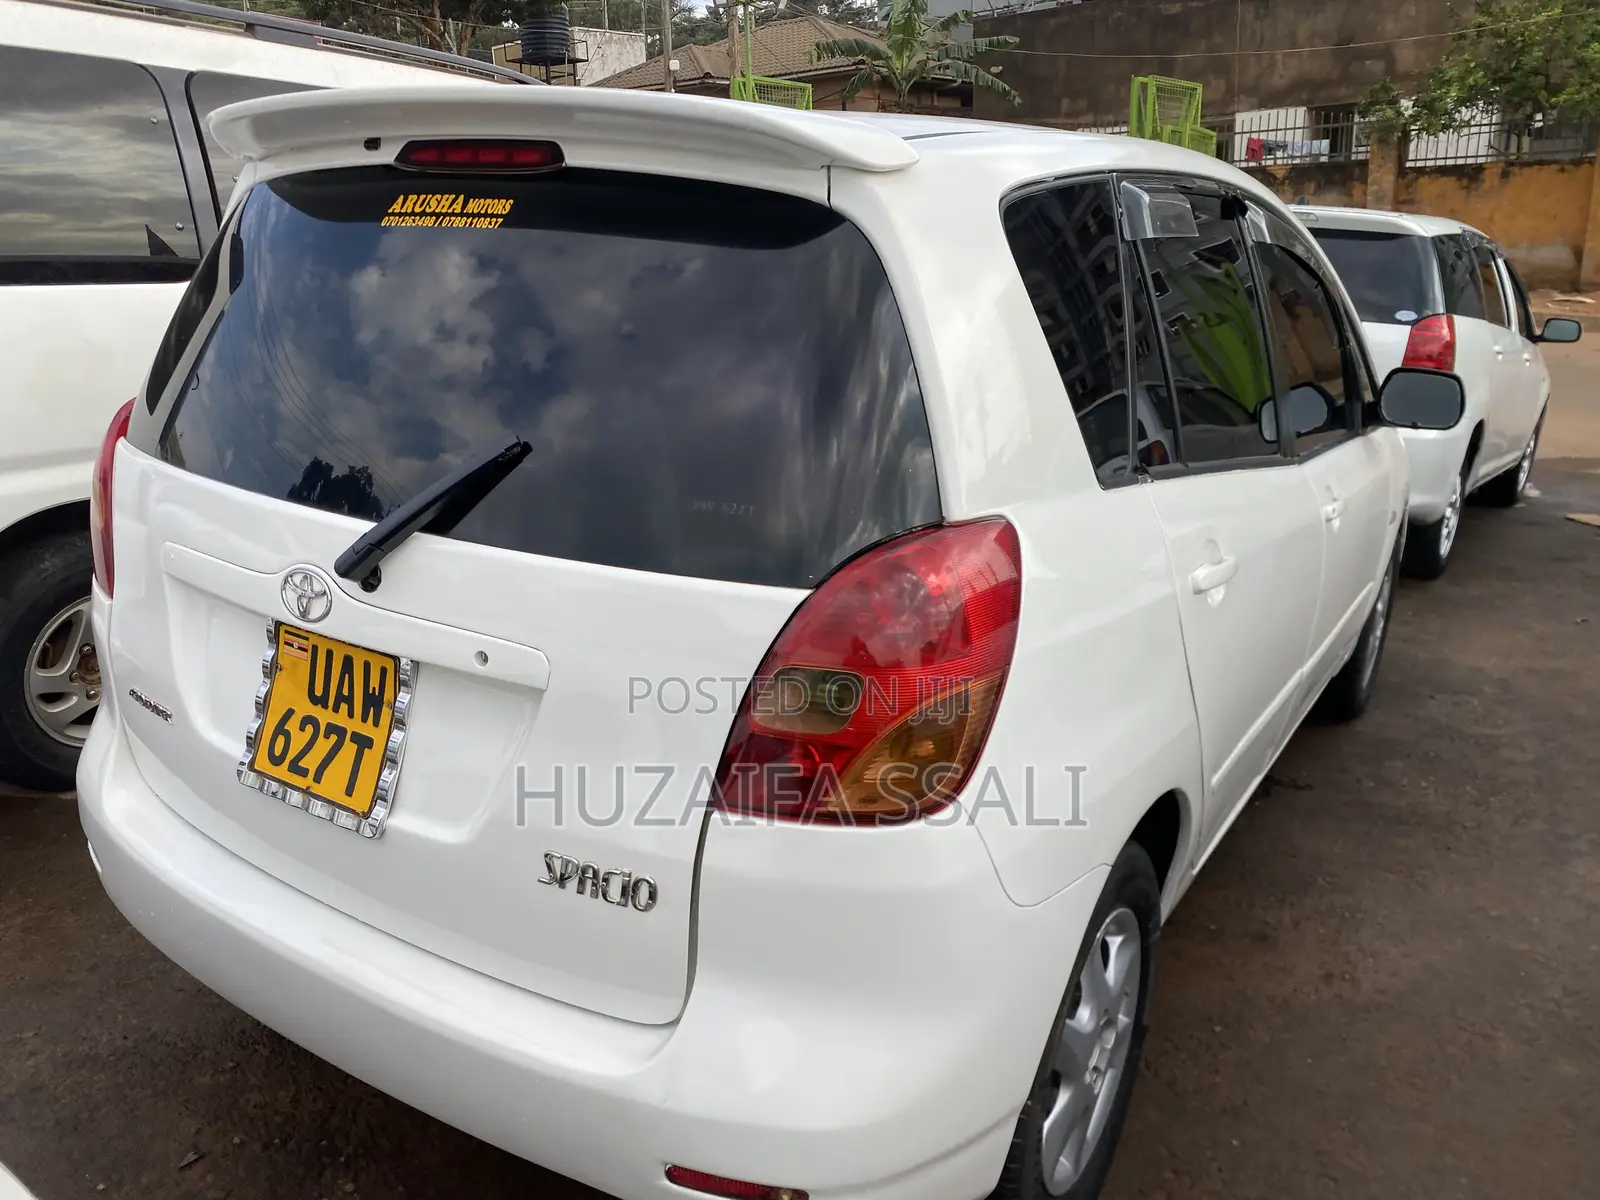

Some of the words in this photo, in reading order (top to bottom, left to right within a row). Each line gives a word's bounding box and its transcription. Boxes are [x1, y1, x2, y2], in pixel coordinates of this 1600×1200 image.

[388, 194, 464, 213] ARUSHA
[465, 198, 513, 215] MOTORS
[307, 644, 388, 728] UAW
[267, 708, 374, 798] 627T
[537, 850, 658, 912] SPACIO
